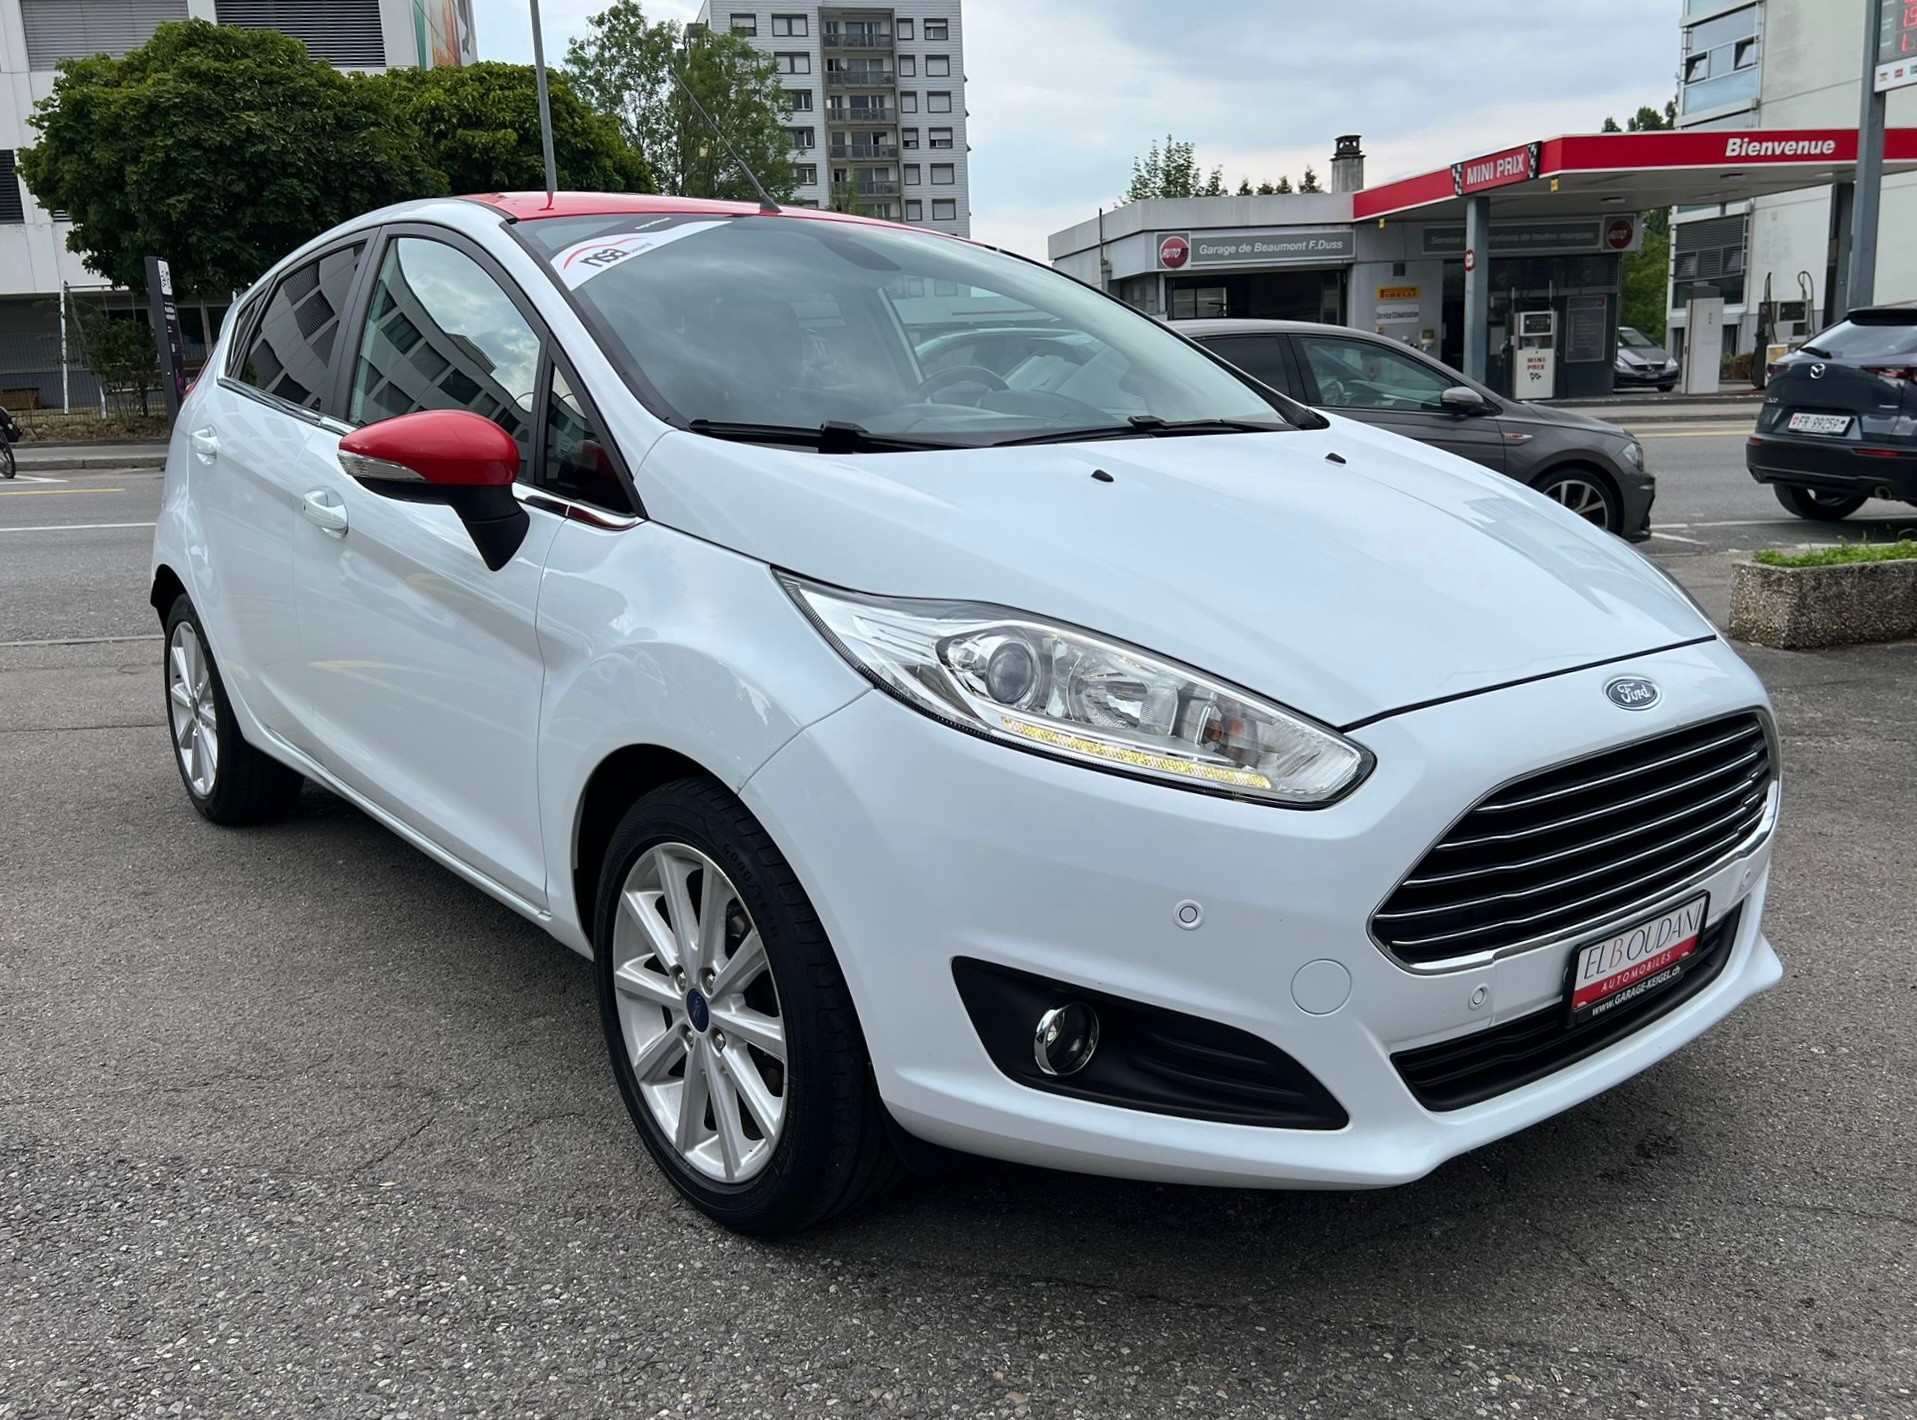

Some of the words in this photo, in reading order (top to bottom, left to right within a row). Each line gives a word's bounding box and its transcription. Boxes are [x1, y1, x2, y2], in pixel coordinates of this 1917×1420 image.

[1725, 138, 1836, 157] Bienvenue
[1466, 161, 1494, 185] MINI
[1496, 154, 1525, 179] PRIX
[580, 248, 629, 268] nsa
[1199, 244, 1236, 256] Garage
[1238, 243, 1251, 254] de
[1254, 240, 1306, 253] Beaumont
[1308, 239, 1344, 250] F.Duss
[1616, 682, 1651, 704] Ford
[1600, 950, 1672, 993] AUTOMOBILES
